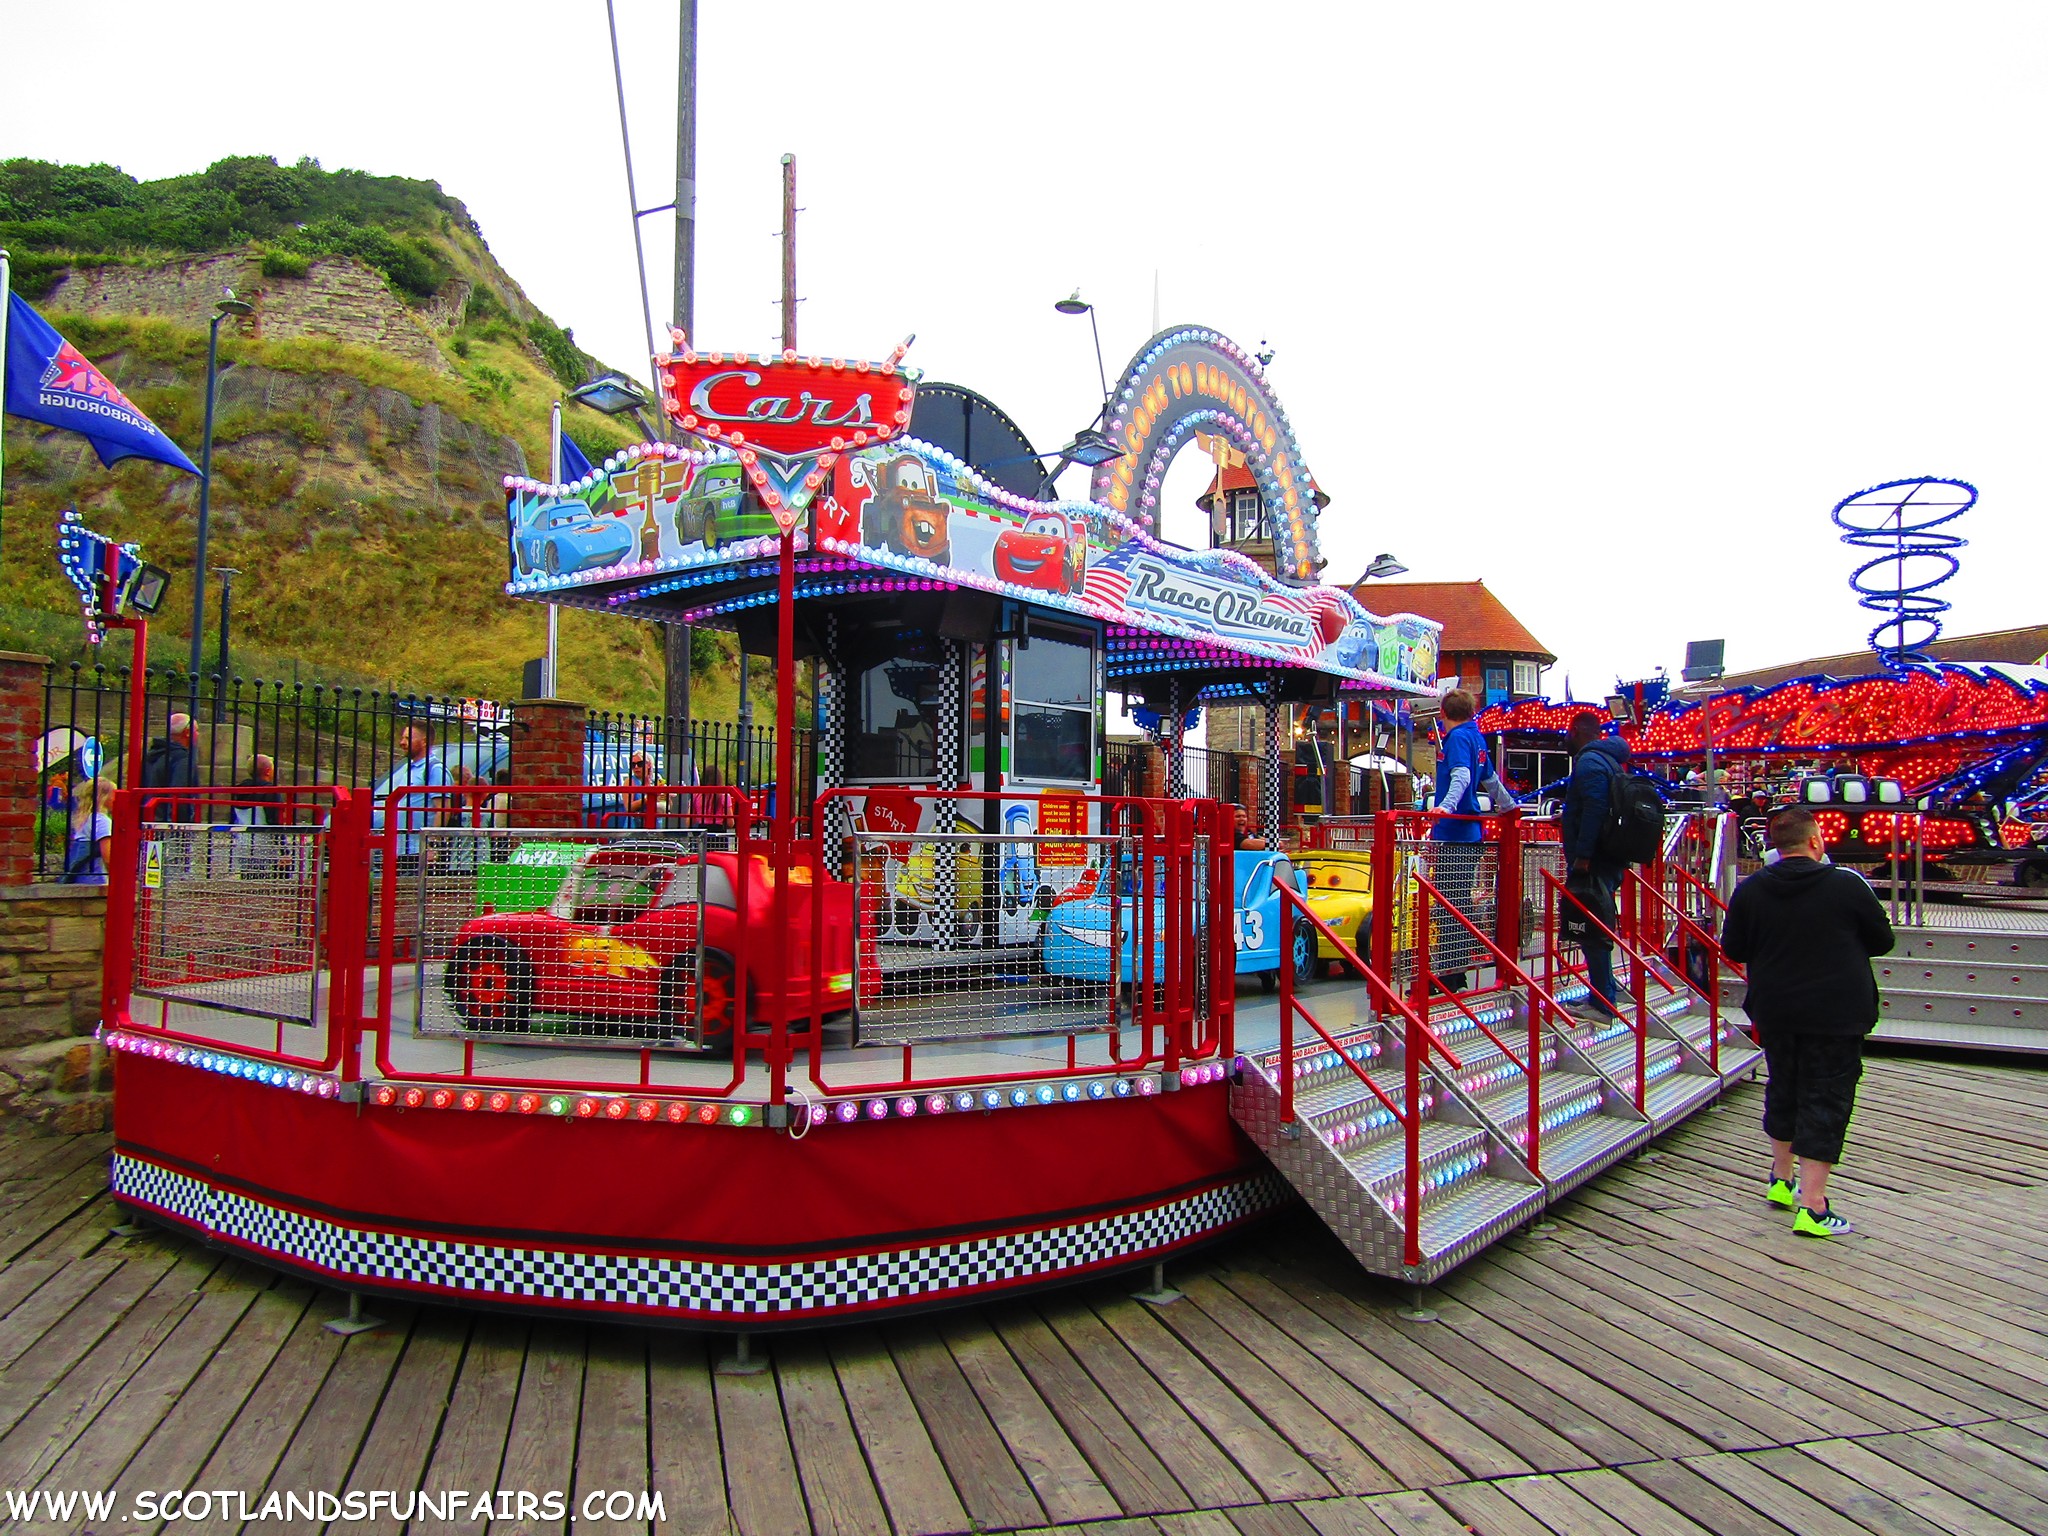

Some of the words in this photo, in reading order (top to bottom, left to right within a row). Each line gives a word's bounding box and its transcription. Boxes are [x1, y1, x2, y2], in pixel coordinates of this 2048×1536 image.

[690, 371, 882, 427] Cars
[1107, 374, 1168, 512] WELCOME
[1167, 361, 1193, 399] TO
[1196, 361, 1276, 455] RADIATOR
[1273, 452, 1311, 579] SPRINGS
[1382, 644, 1398, 670] 66
[874, 805, 907, 833] START
[1234, 910, 1264, 951] 43
[1303, 1045, 1317, 1057] BACK
